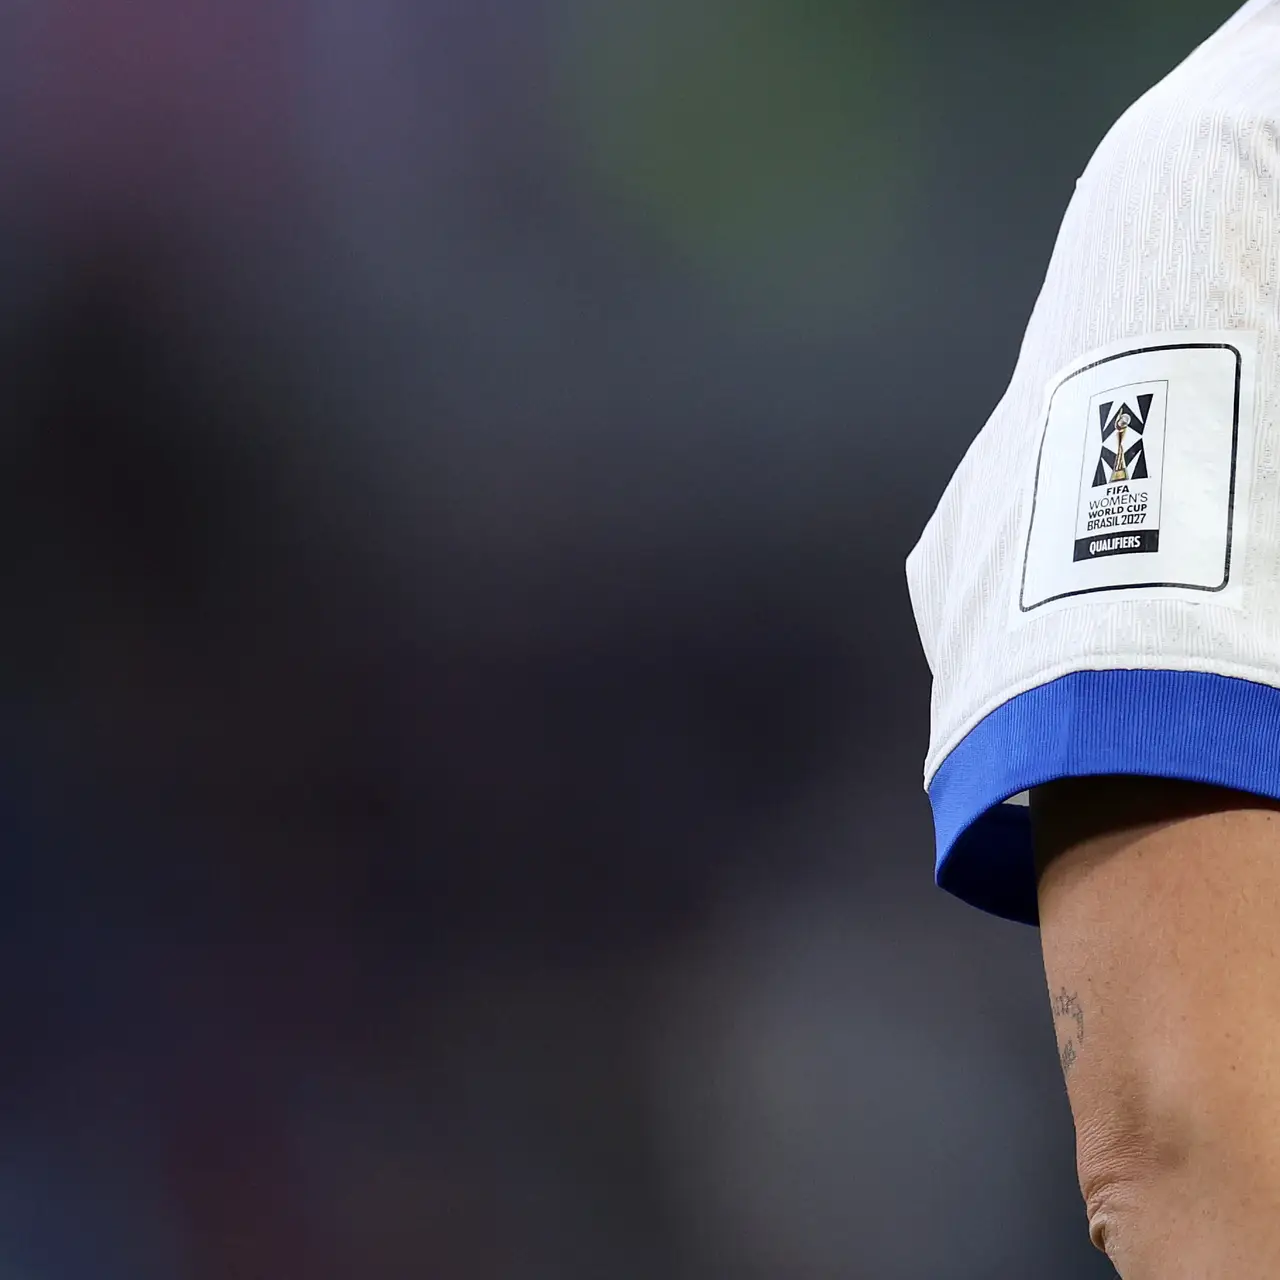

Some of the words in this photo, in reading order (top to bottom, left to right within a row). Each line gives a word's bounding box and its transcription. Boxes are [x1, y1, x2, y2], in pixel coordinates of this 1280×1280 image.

[1106, 485, 1129, 496] FIFA
[1089, 492, 1148, 510] WOMEN'S
[1088, 506, 1124, 519] WORLD
[1127, 503, 1147, 513] CUP
[1087, 516, 1119, 531] BRASIL
[1121, 513, 1146, 525] 2027
[1089, 535, 1141, 555] QUALIFIERS
